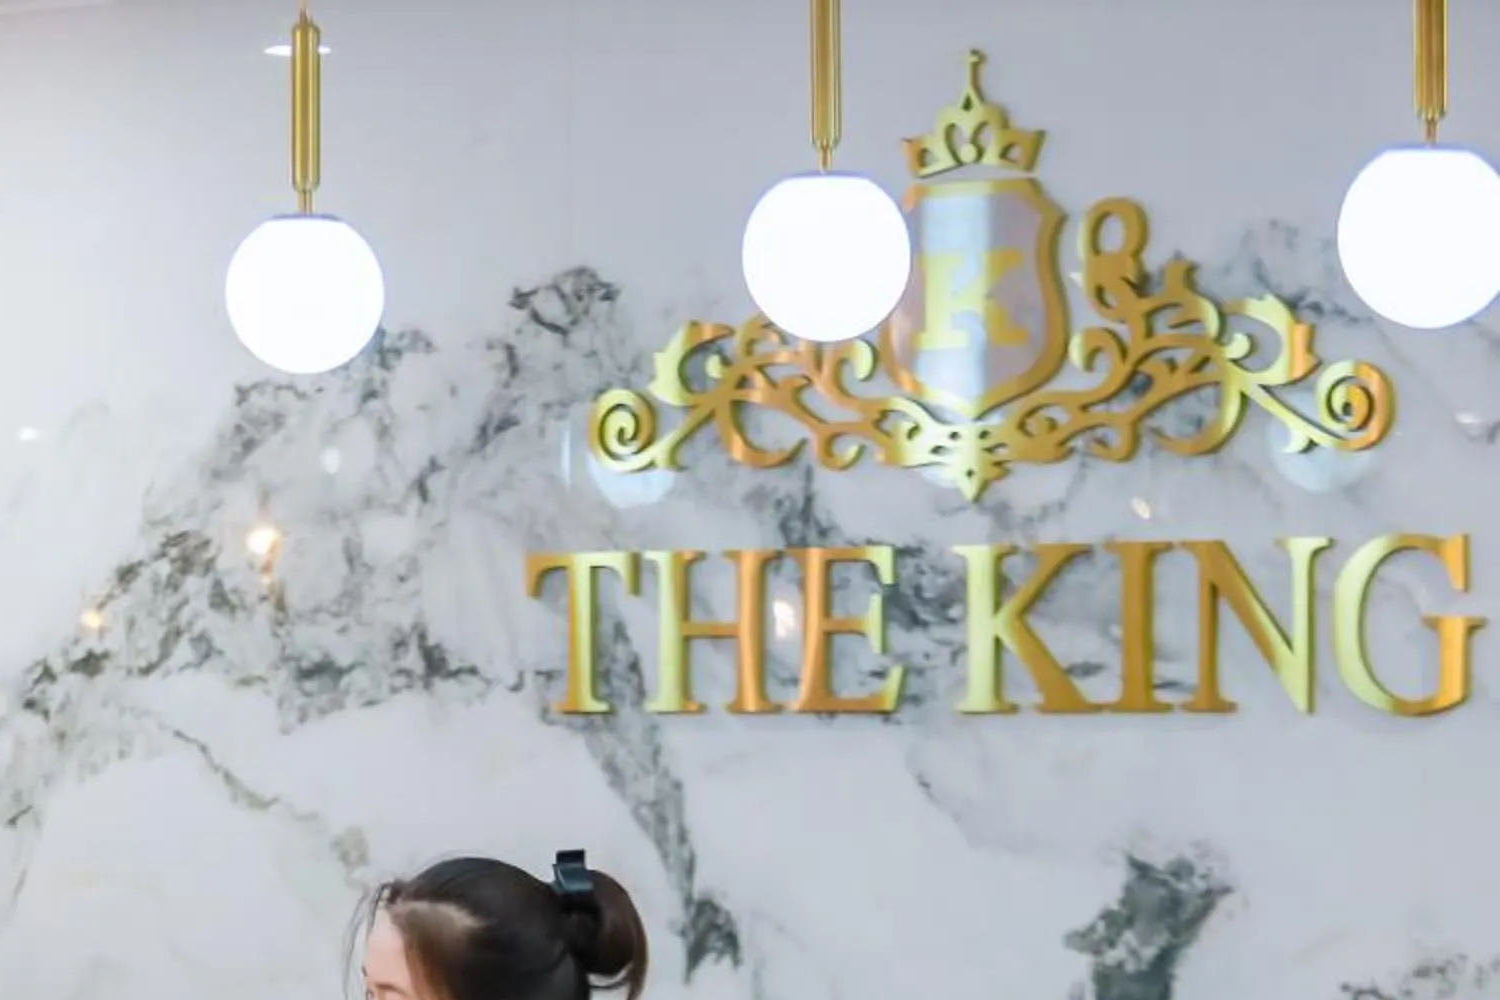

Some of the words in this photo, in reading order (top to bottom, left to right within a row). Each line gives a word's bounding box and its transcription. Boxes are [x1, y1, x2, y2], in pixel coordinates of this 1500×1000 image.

[915, 249, 1030, 349] K
[524, 543, 902, 714] THE
[952, 532, 1486, 716] KING
